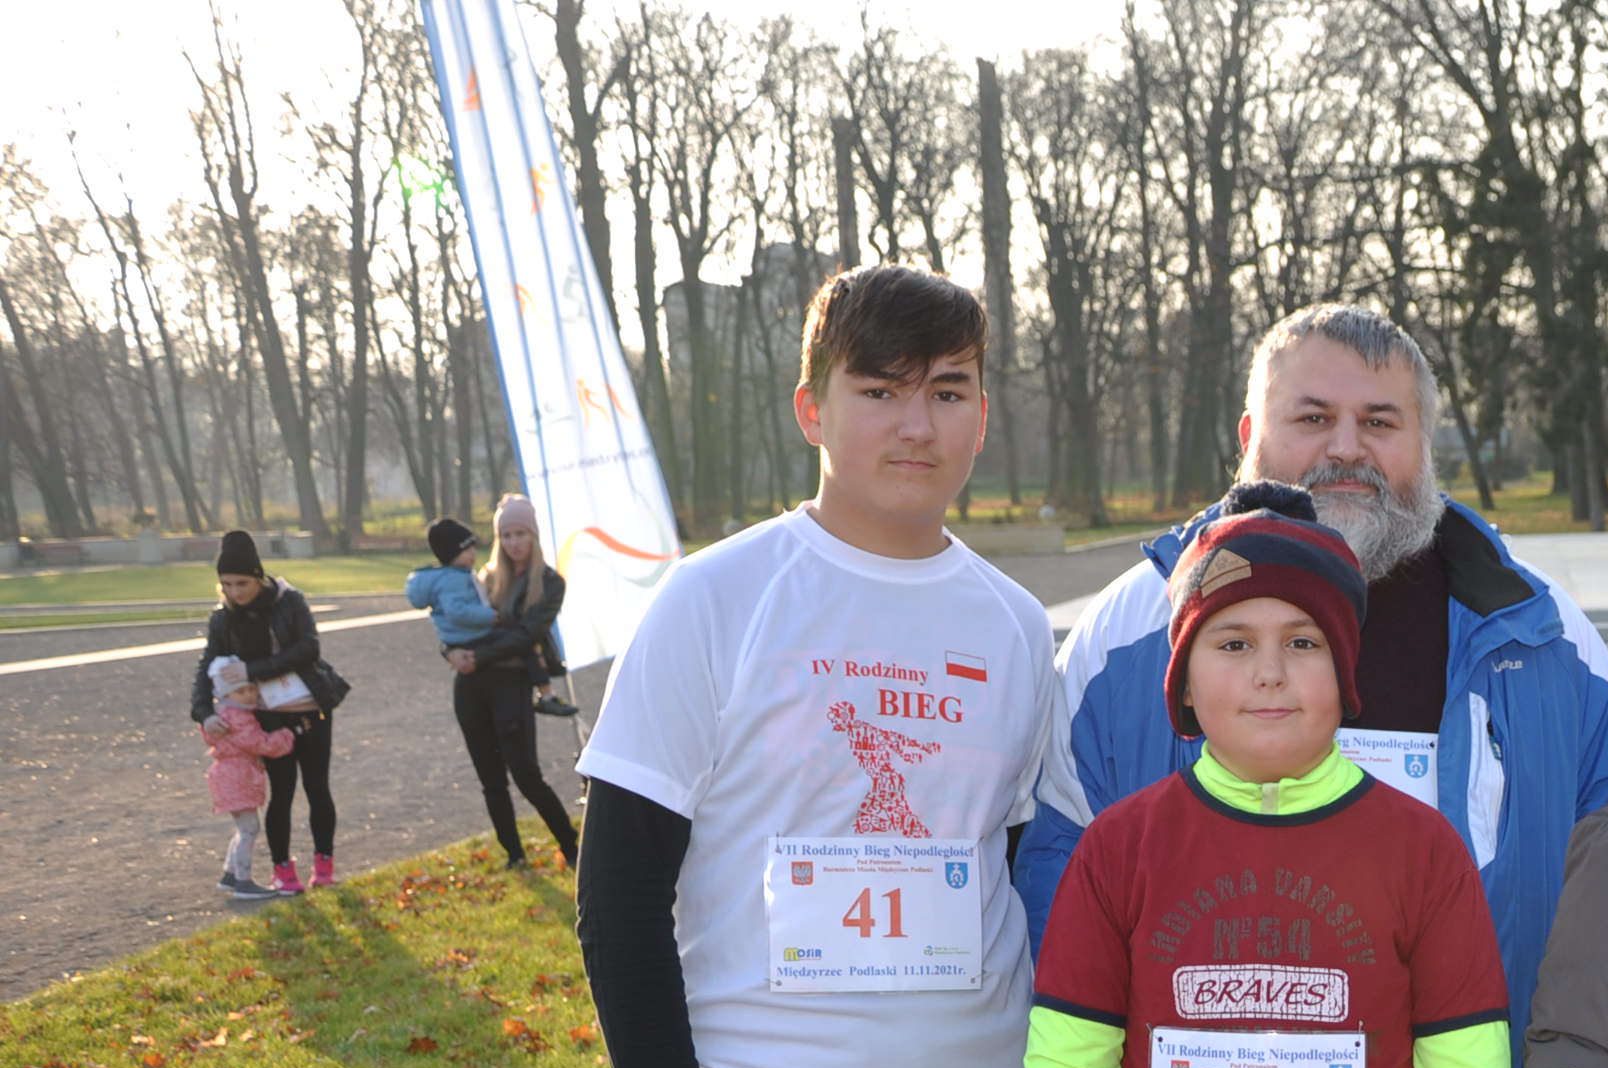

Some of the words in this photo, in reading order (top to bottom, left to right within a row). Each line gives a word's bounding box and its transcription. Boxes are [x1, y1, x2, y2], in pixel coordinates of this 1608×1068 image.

[811, 659, 836, 675] IV
[844, 660, 929, 686] Rodzinny
[877, 688, 964, 723] BIEG
[1353, 737, 1434, 750] Niepodległośc
[802, 844, 859, 859] Rodzinny
[864, 845, 891, 859] Bieg
[842, 887, 909, 938] 41
[776, 966, 843, 979] Międzyrzec
[849, 965, 897, 976] Podlaski
[904, 964, 966, 975] 11.11.2021r.
[1194, 979, 1329, 1006] BRAVES
[1158, 1044, 1176, 1056] VII
[1179, 1044, 1233, 1060] Rodzinny
[1237, 1047, 1266, 1062] Bieg
